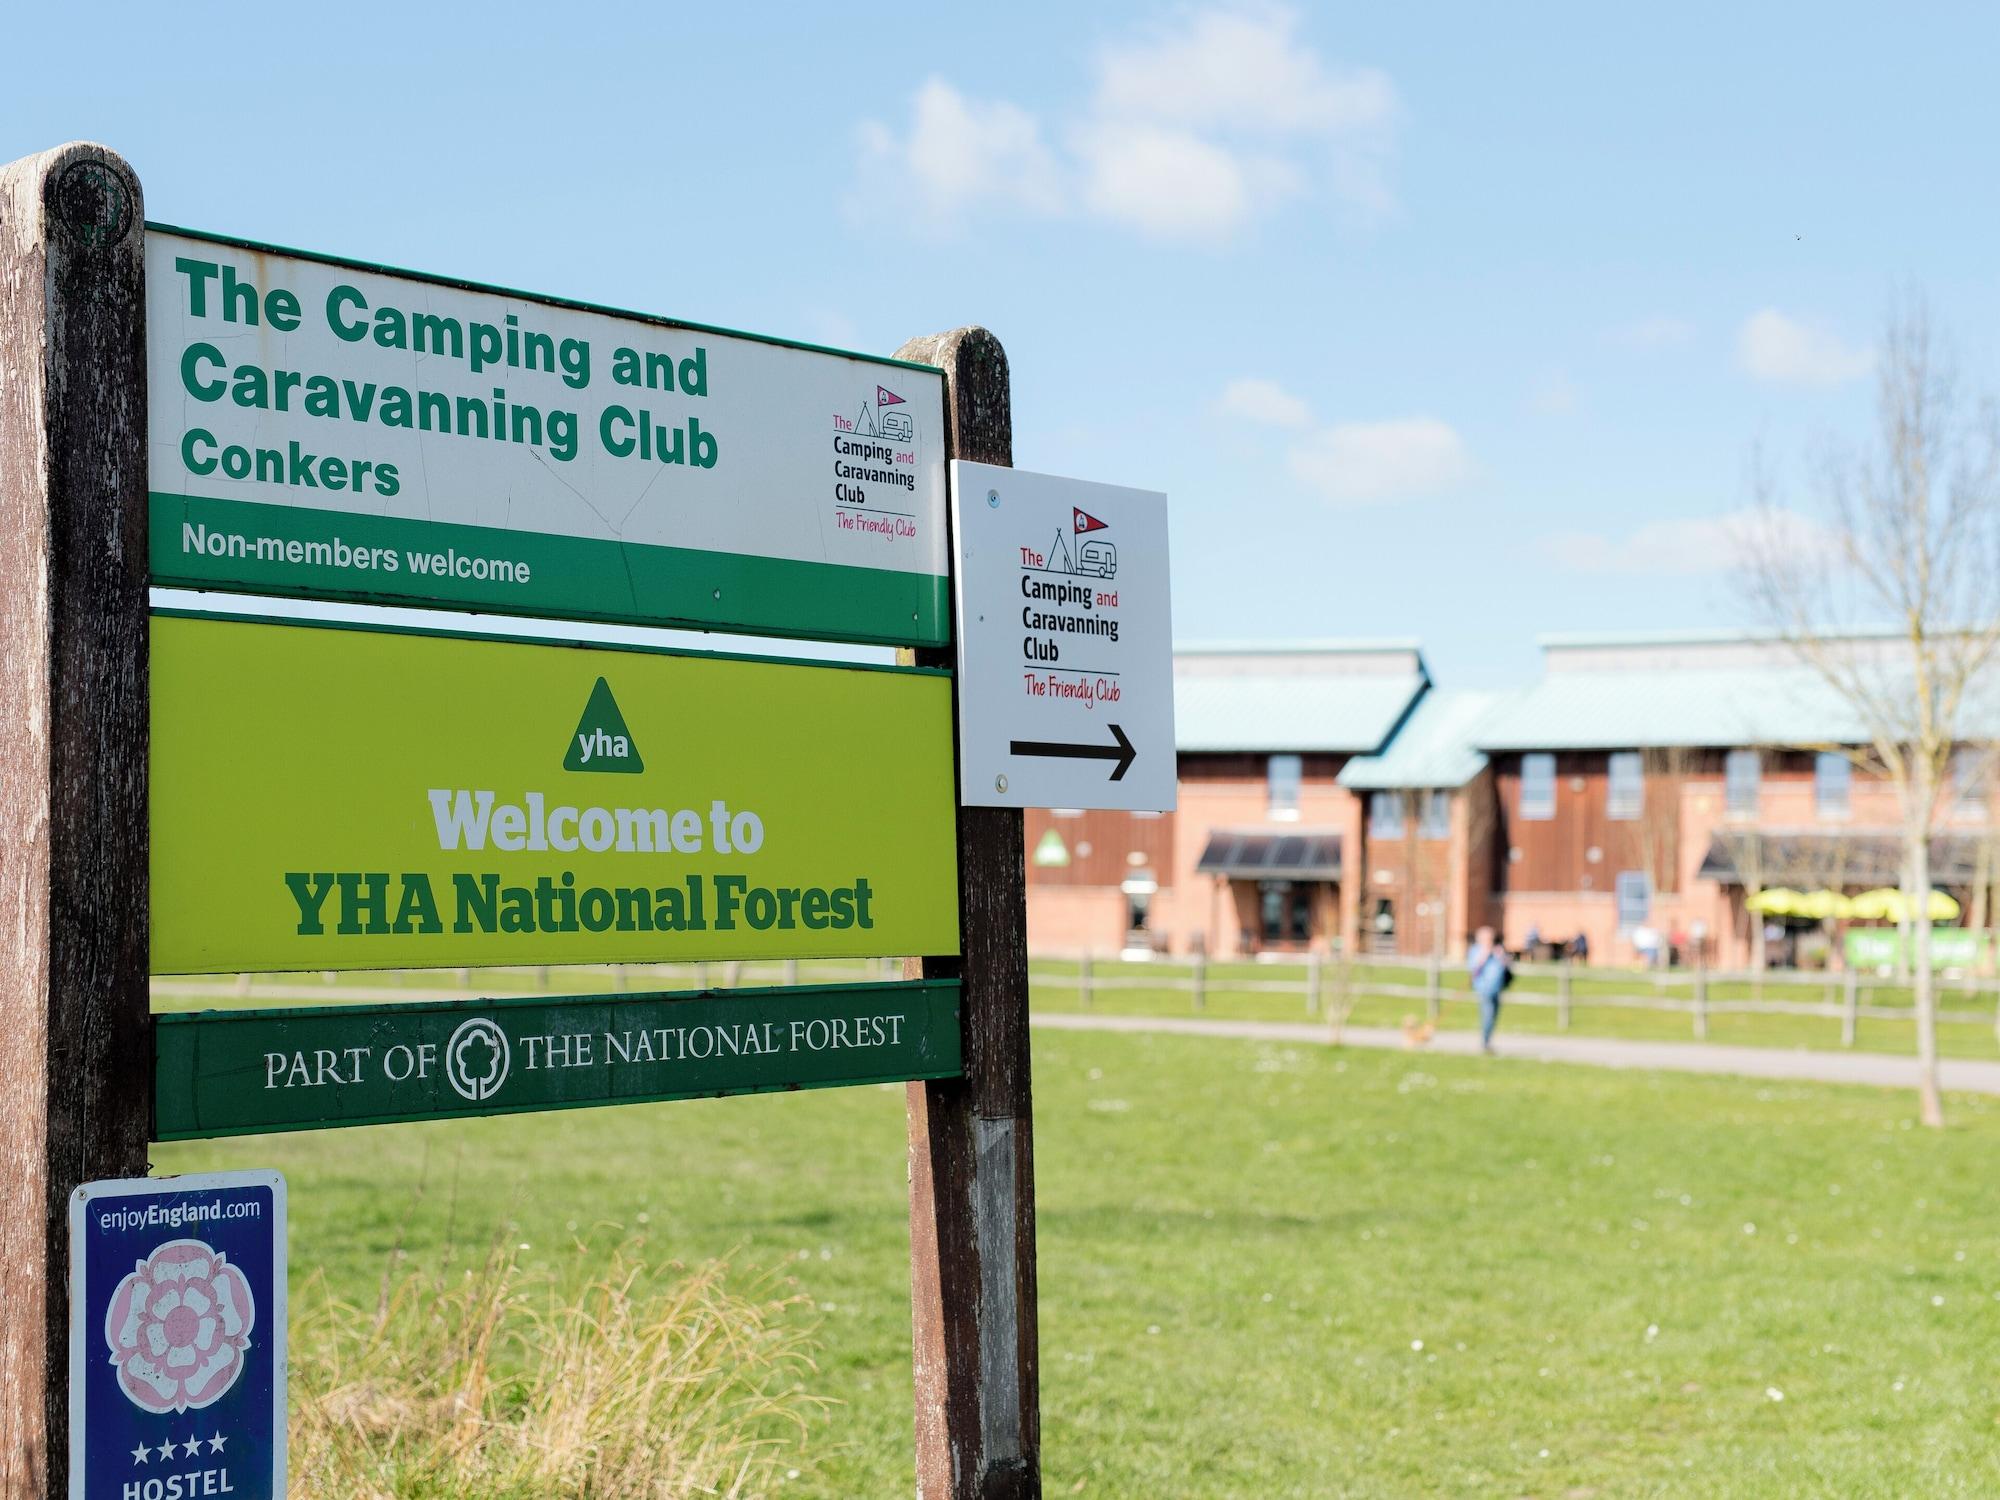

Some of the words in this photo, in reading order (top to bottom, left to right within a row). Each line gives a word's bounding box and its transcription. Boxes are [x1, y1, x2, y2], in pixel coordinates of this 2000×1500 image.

[175, 257, 301, 332] The
[326, 285, 591, 389] Camping
[612, 347, 708, 397] and
[180, 342, 578, 461] Caravanning
[599, 405, 718, 469] Club
[833, 414, 852, 430] The
[181, 428, 400, 497] Conkers
[834, 436, 893, 465] Camping
[896, 451, 914, 464] and
[835, 460, 914, 491] Caravanning
[835, 483, 865, 504] Club
[836, 511, 854, 530] The
[856, 514, 894, 542] Friendly
[895, 518, 916, 538] Club
[182, 522, 399, 572] Non-members
[406, 549, 531, 583] welcome
[1020, 547, 1043, 567] The
[1021, 575, 1093, 609] Camping
[1096, 591, 1119, 607] and
[1022, 606, 1119, 642] Caravanning
[1023, 636, 1059, 662] Club
[1024, 673, 1046, 696] The
[1048, 675, 1094, 709] Friendly
[1096, 678, 1121, 701] Club
[578, 728, 629, 763] yha
[428, 789, 703, 854] Welcome
[709, 800, 764, 854] to
[285, 872, 443, 935] YHA
[453, 871, 707, 933] National
[713, 875, 874, 931] Forest
[263, 1047, 371, 1089] PART
[383, 1043, 437, 1081] OF
[519, 1034, 593, 1070] THE
[604, 1023, 781, 1065] NATIONAL
[789, 1015, 905, 1053] FOREST
[100, 1199, 261, 1231] enjoyEngland.com
[123, 1468, 234, 1500] HOSTEL
